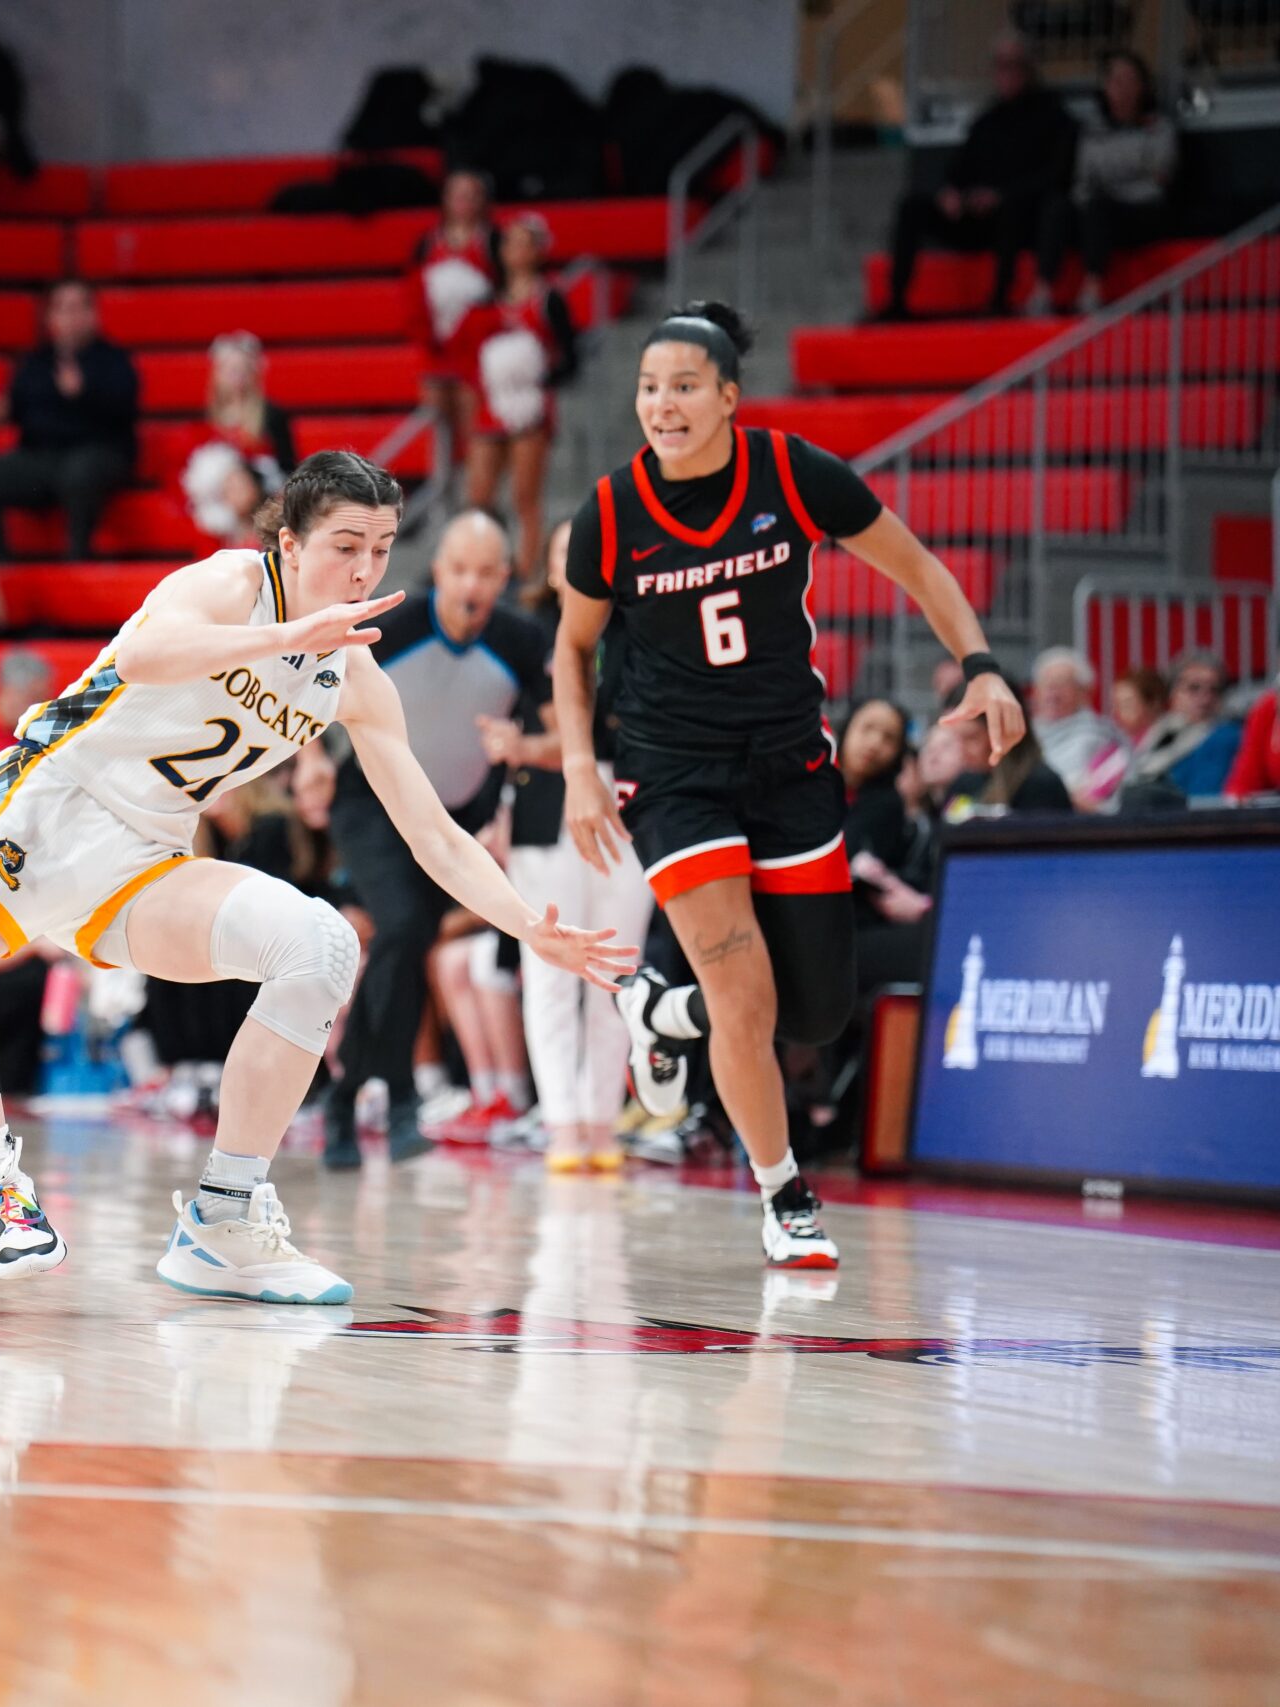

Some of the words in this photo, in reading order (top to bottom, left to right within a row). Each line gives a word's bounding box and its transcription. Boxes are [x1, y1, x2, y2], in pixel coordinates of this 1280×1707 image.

[636, 541, 791, 596] FAIRFIELD
[698, 588, 748, 668] 6
[209, 666, 326, 747] OBCATS
[149, 716, 270, 802] 21
[979, 979, 1110, 1036] MERIDIAN
